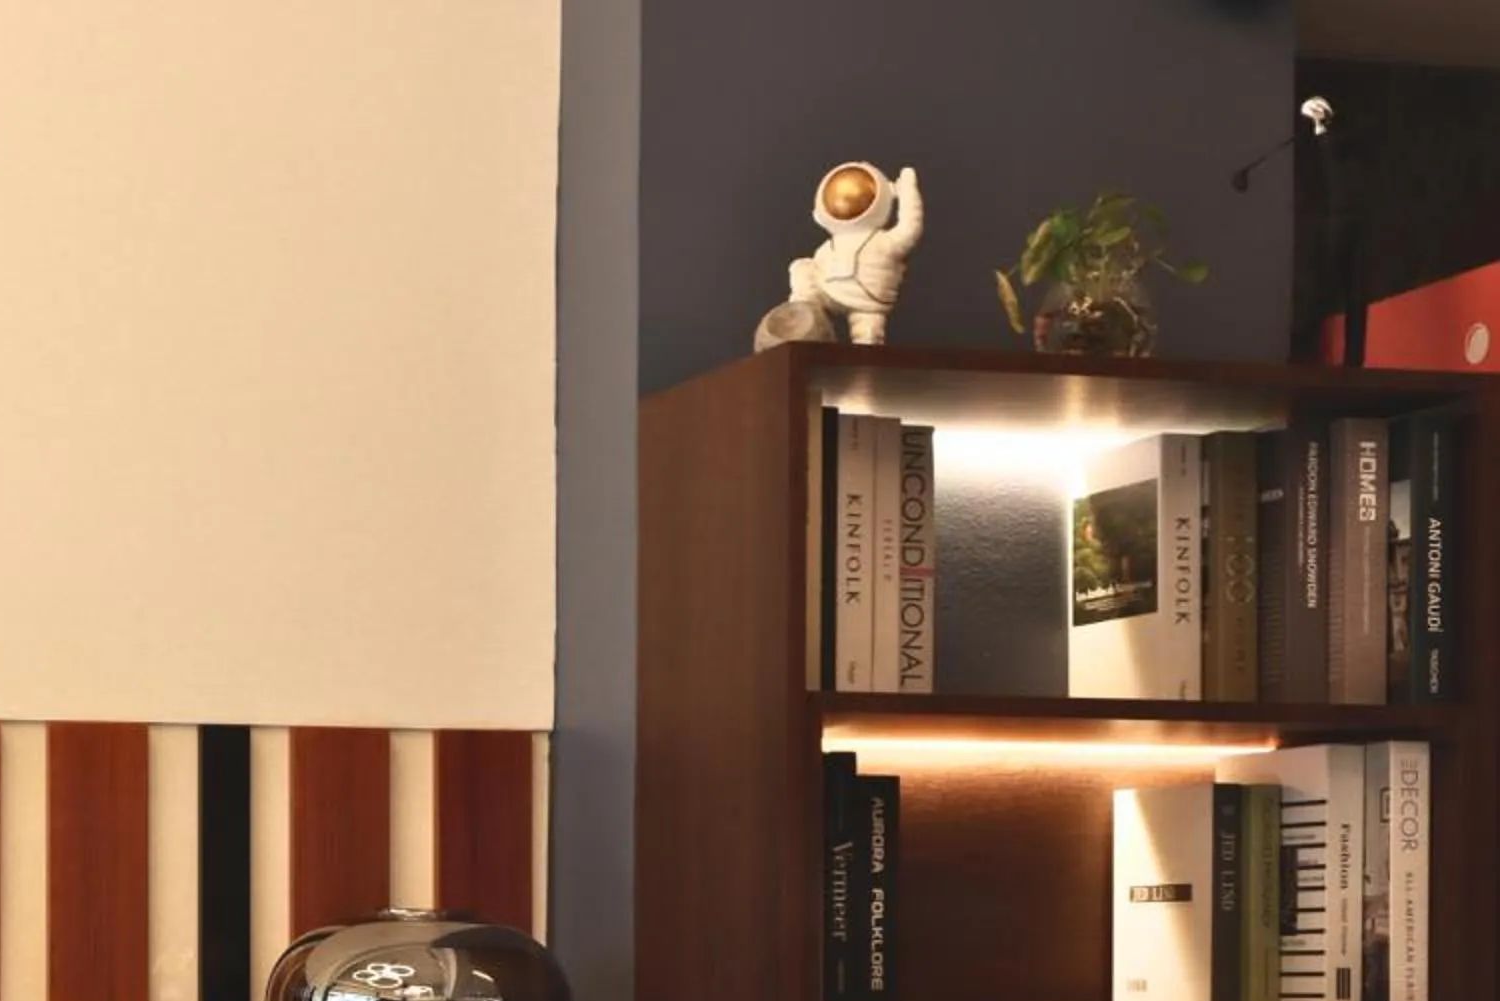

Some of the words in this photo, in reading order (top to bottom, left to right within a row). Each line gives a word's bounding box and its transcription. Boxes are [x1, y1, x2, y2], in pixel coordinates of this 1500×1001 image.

[1307, 493, 1319, 545] EDWARD
[1359, 441, 1377, 522] HOMES
[846, 494, 862, 604] KINFOLK
[901, 430, 926, 687] UNCONDITIONAL
[1175, 516, 1191, 624] KINFOLK
[1307, 548, 1319, 608] SNOWDEN
[1428, 516, 1442, 582] ANTONI
[871, 797, 885, 874] AURORA
[832, 842, 853, 942] Vermeer
[871, 888, 885, 991] FOLKLORE
